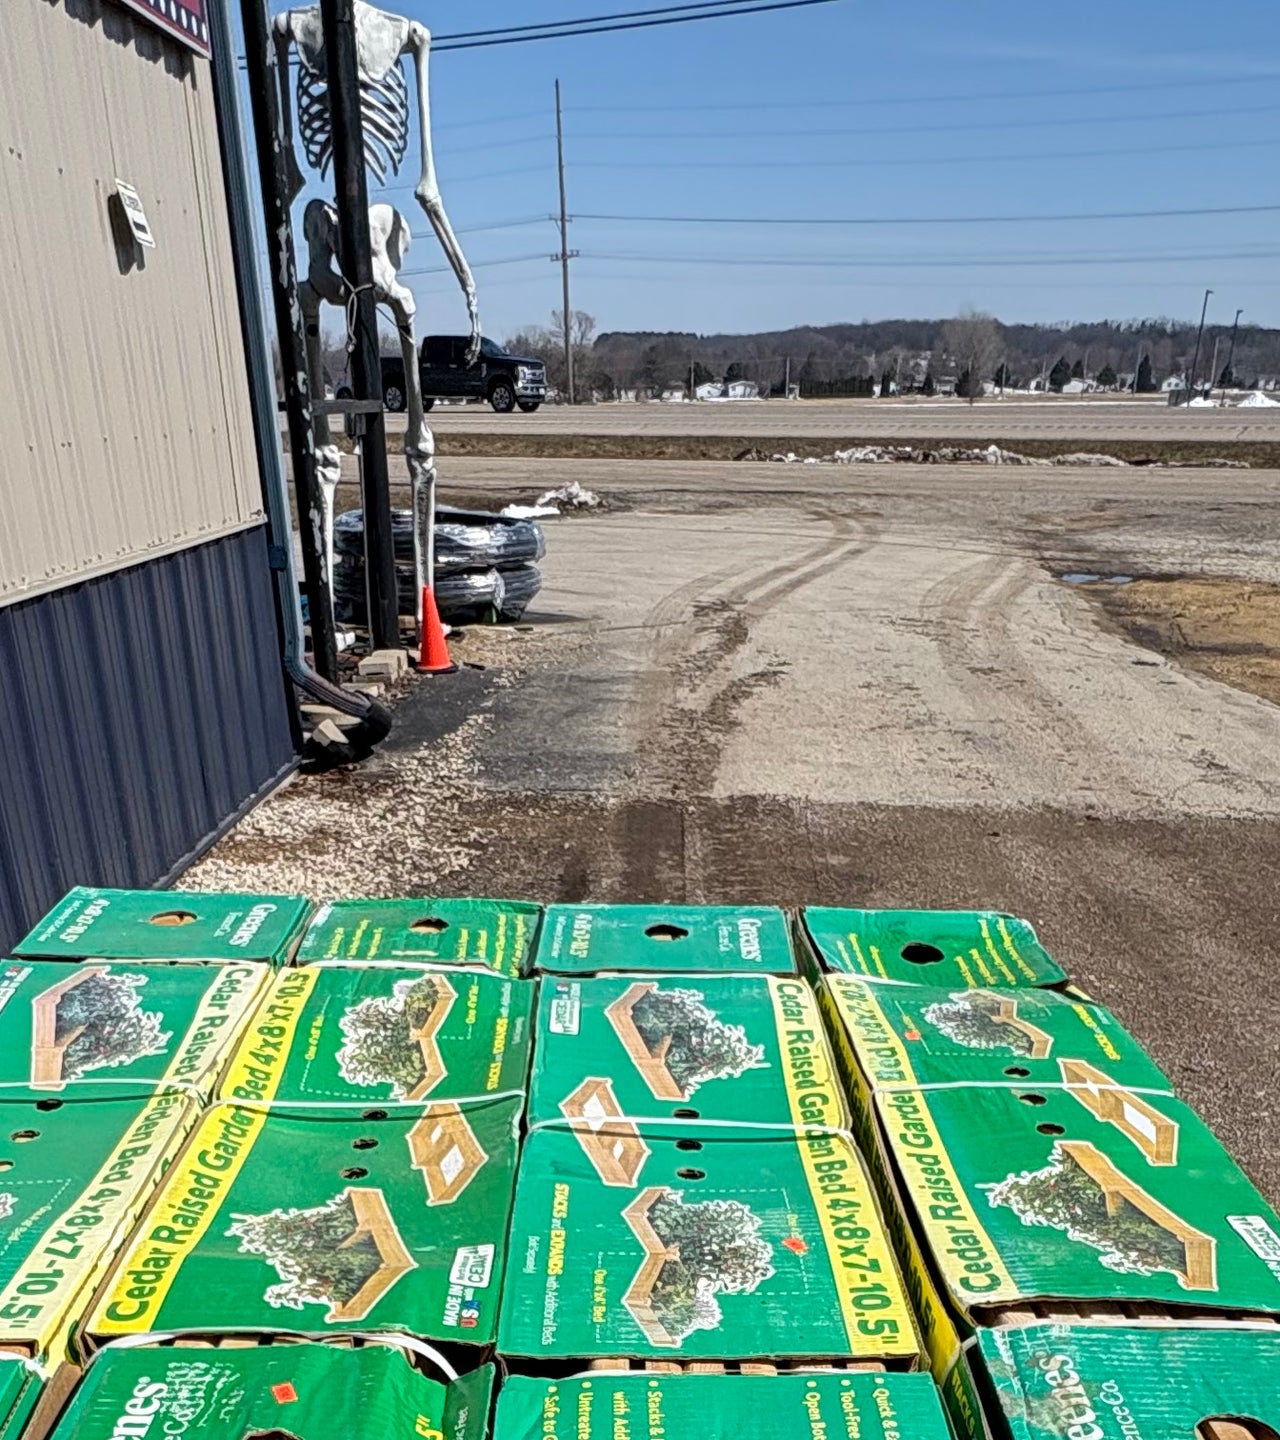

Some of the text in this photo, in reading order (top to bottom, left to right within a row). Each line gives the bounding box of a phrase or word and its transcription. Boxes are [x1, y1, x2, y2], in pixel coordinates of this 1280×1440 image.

[207, 968, 253, 1012] Cedar
[776, 982, 805, 1026] Cedar
[172, 1013, 229, 1077] Raised
[786, 1028, 817, 1091] Raised
[100, 1143, 152, 1184] Bed
[813, 1159, 856, 1196] Bed
[105, 1246, 178, 1323] Cedar
[149, 1169, 223, 1244] Raised
[232, 1063, 273, 1101] Bed
[906, 1152, 968, 1223] Raised
[468, 1252, 489, 1284] CEDAR
[947, 1228, 1002, 1295] Cedar
[442, 1295, 462, 1327] MADE
[460, 1299, 481, 1328] USA
[542, 1394, 561, 1419] Safe
[542, 1420, 558, 1432] to
[802, 1391, 822, 1421] Open
[840, 1389, 861, 1440] Tool-Free
